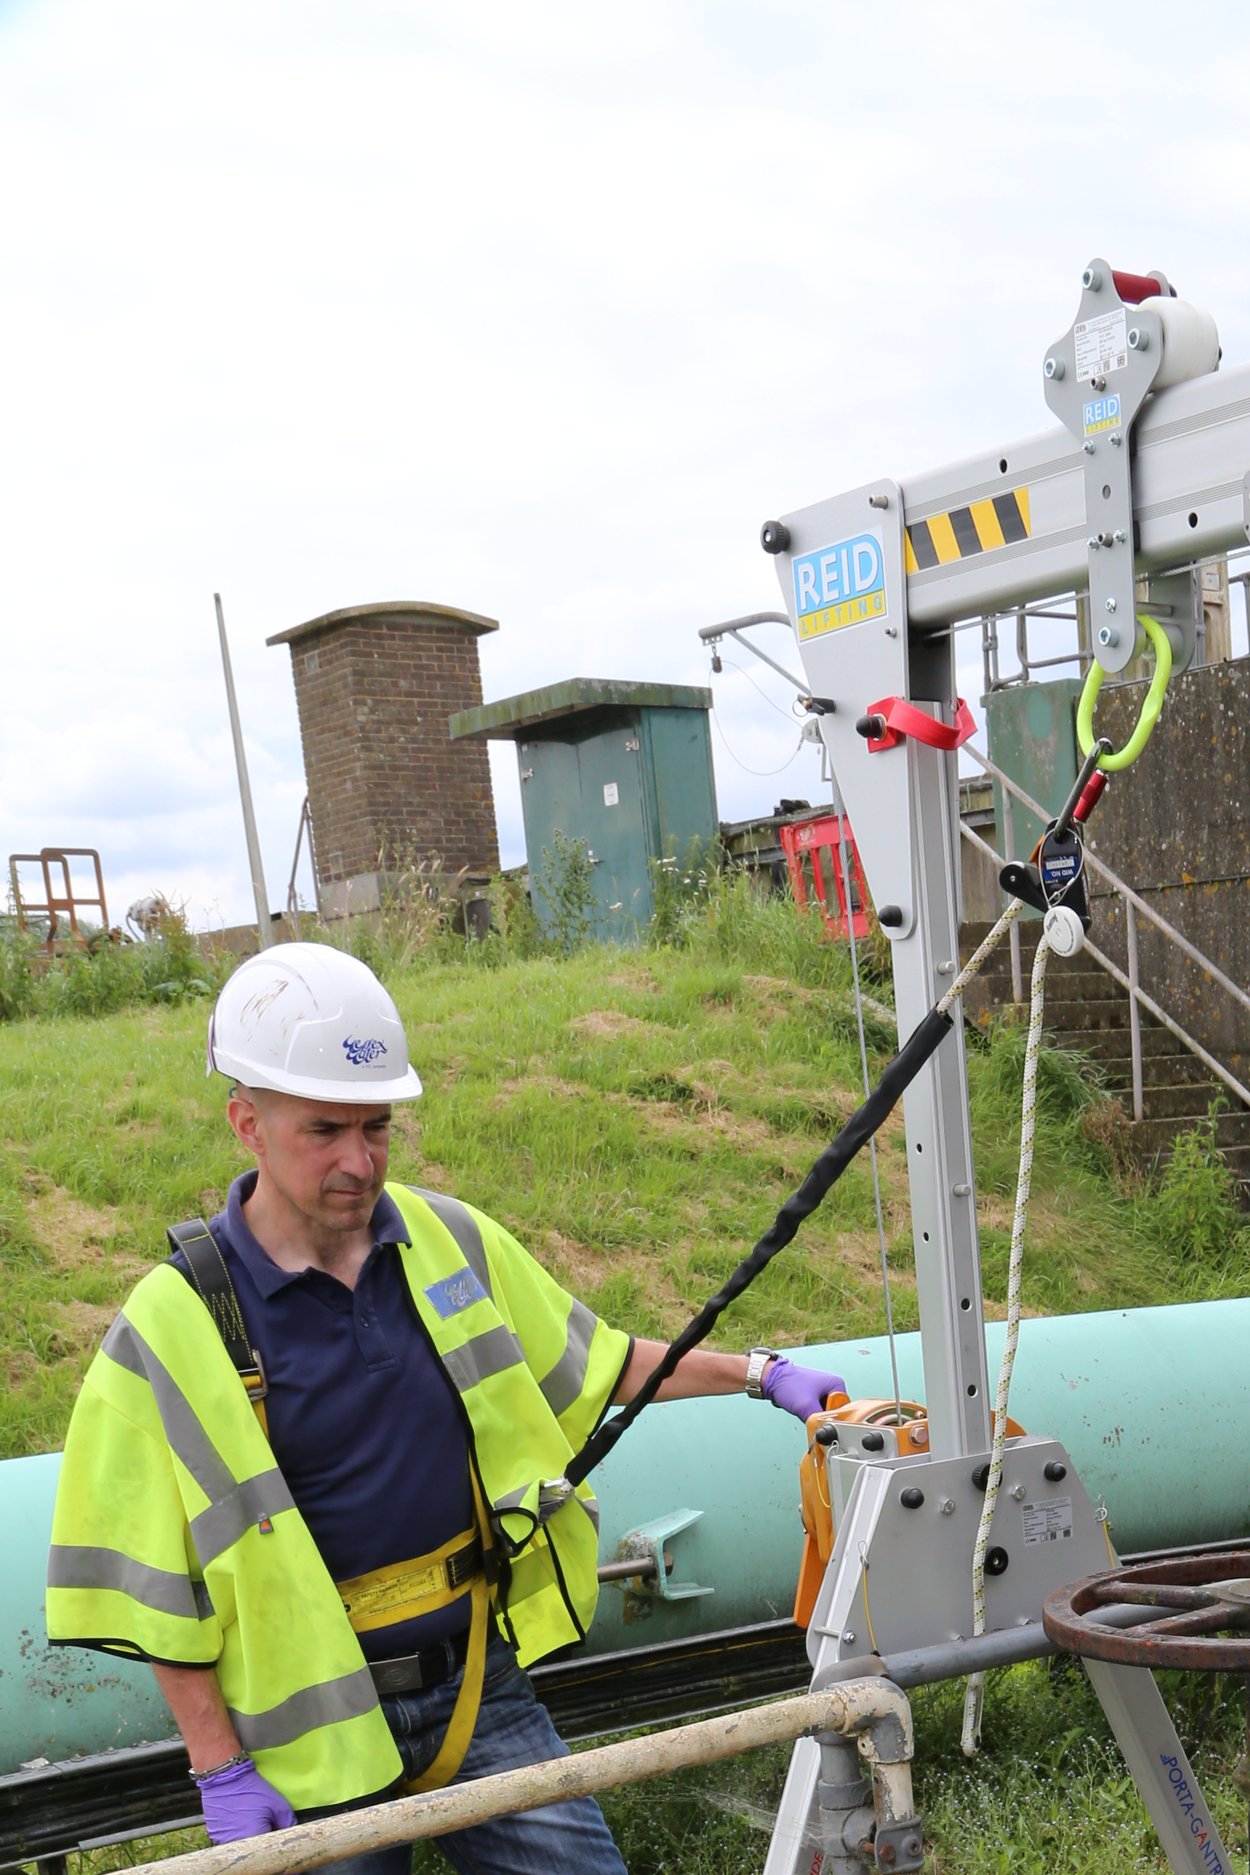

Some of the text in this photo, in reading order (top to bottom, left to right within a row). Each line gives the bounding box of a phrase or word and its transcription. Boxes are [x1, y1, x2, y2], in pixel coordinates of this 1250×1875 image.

[1085, 398, 1118, 425] REID
[798, 541, 879, 612] REID
[801, 594, 882, 635] LIFTING
